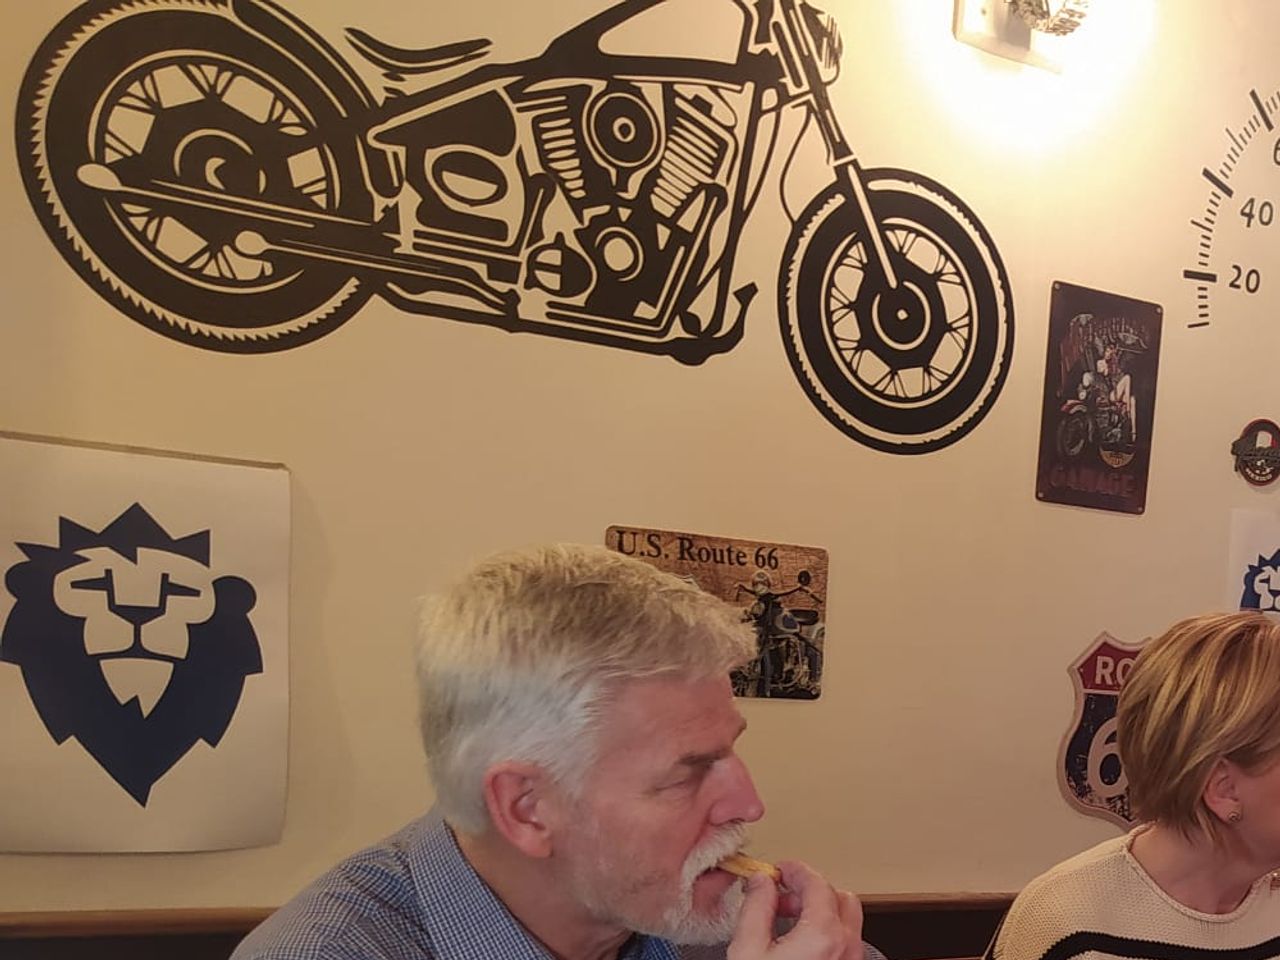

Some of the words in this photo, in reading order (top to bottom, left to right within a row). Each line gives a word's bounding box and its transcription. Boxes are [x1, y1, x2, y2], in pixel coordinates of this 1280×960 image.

[1239, 197, 1274, 229] 40
[1228, 264, 1261, 294] 20
[616, 530, 669, 560] U.S.
[678, 536, 747, 566] Route
[754, 546, 779, 570] 66
[1087, 717, 1129, 798] 6
